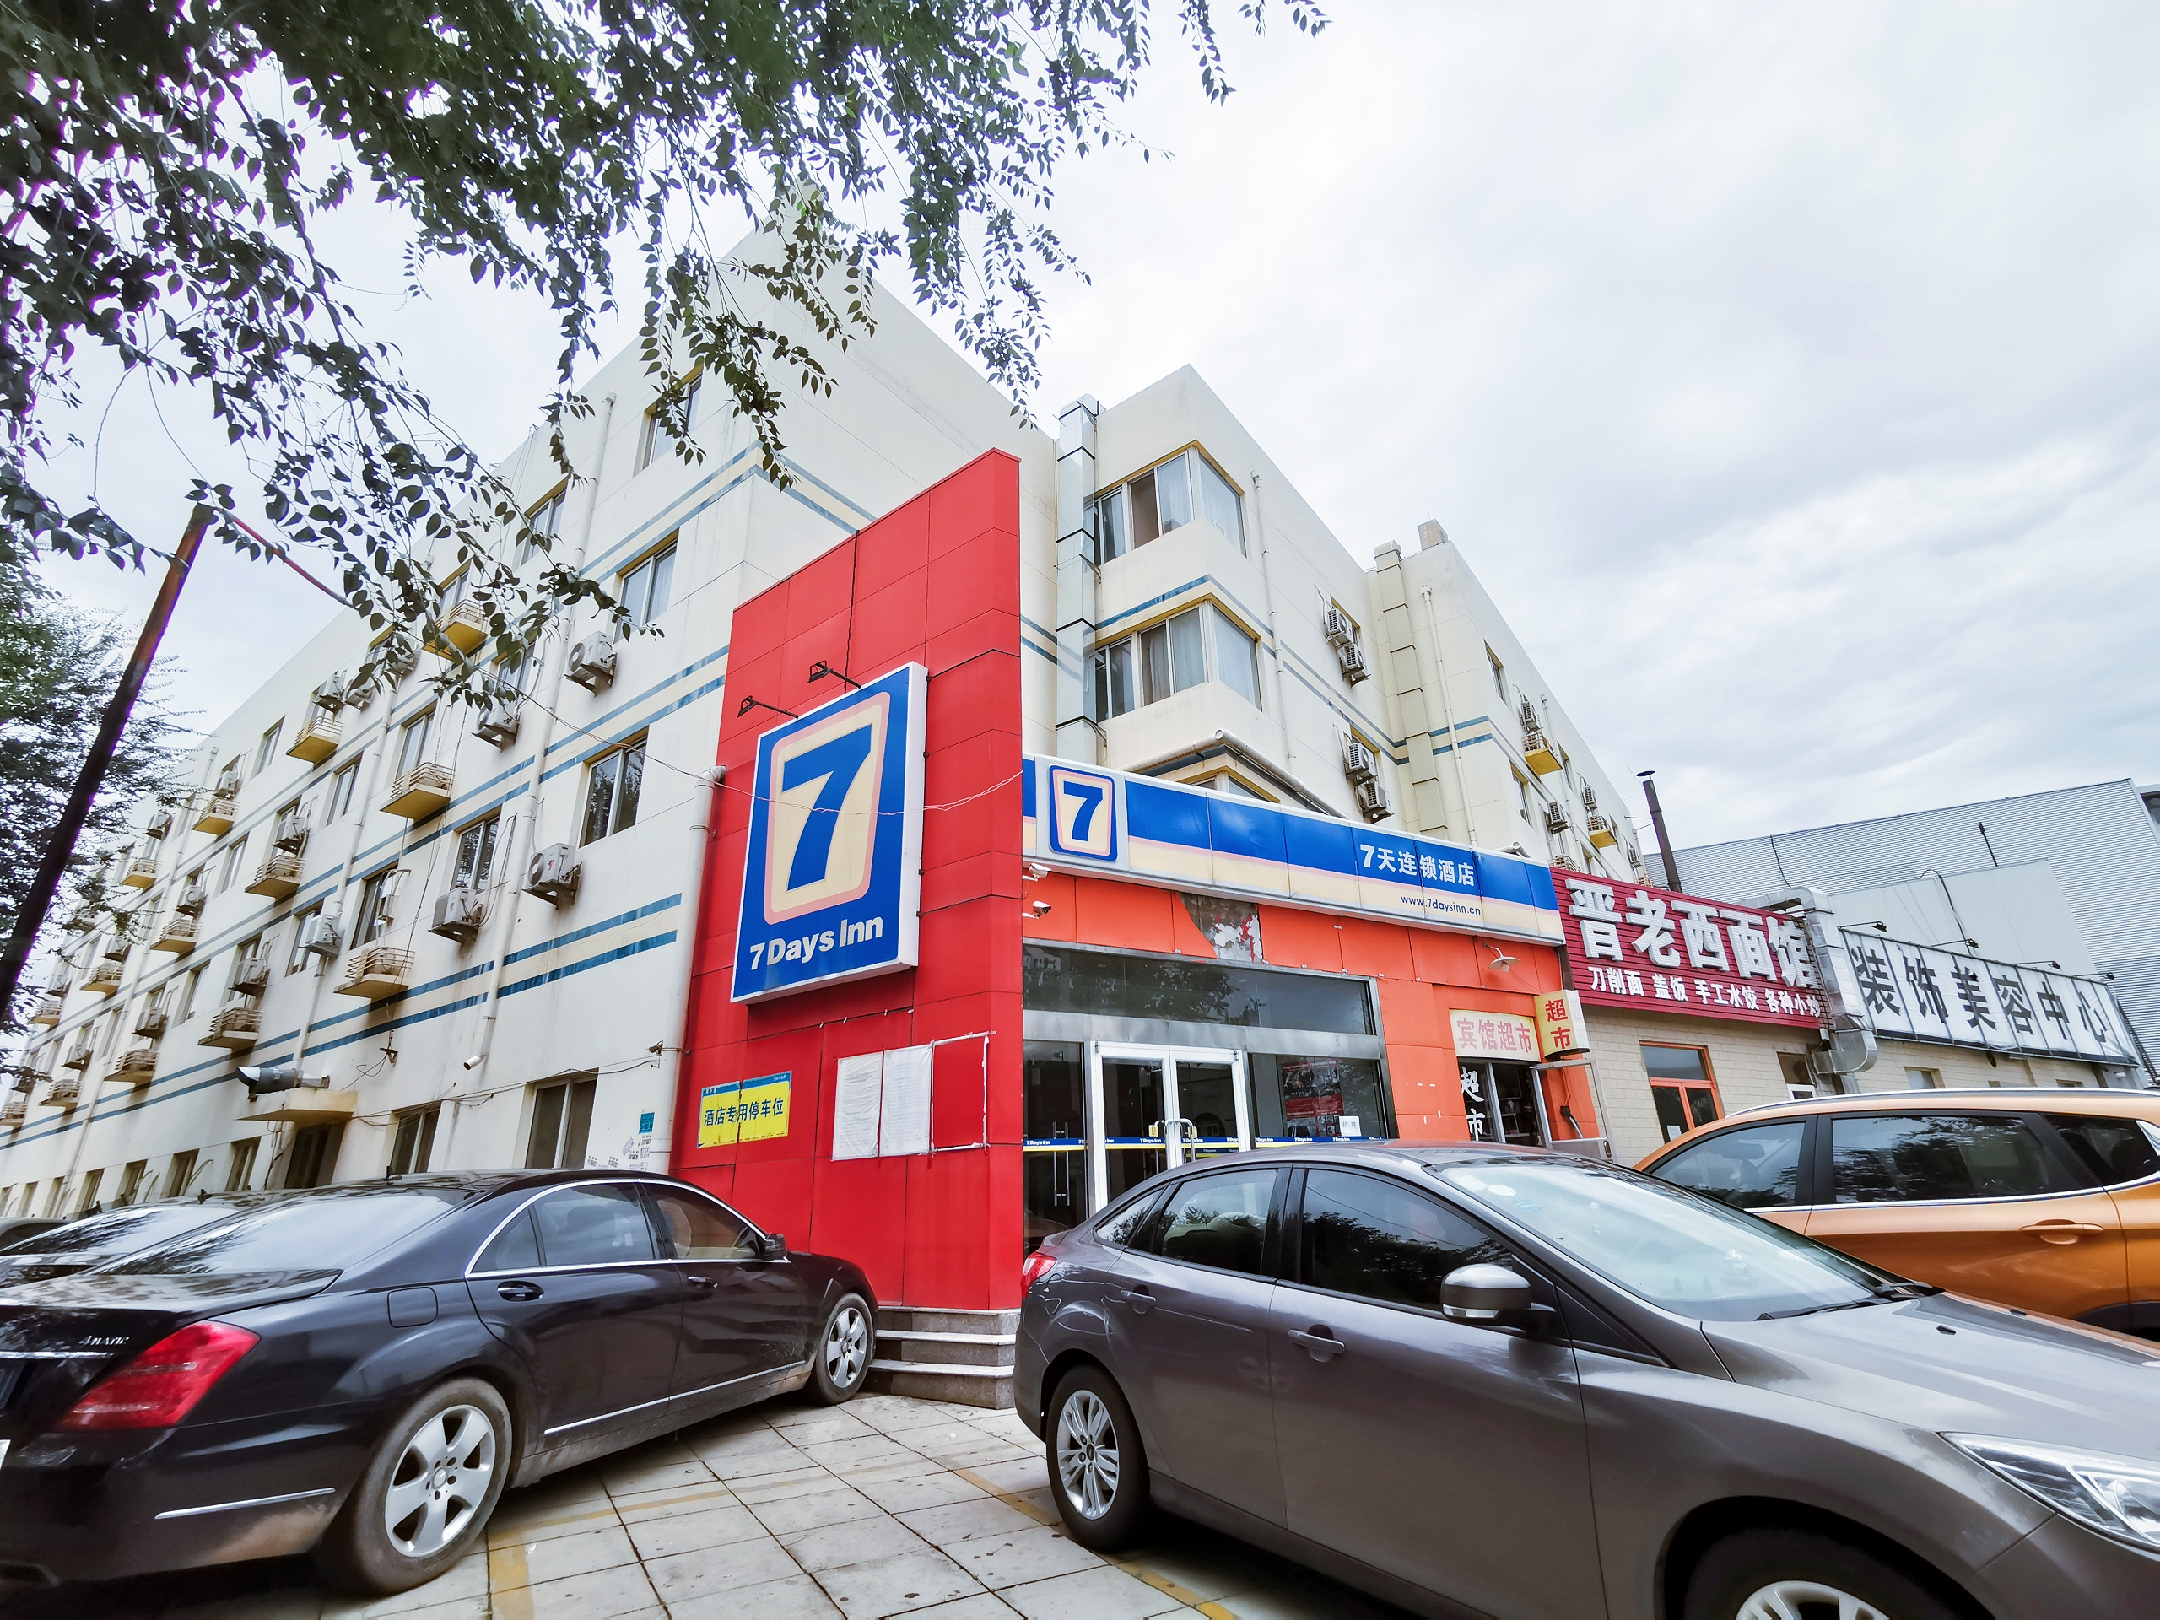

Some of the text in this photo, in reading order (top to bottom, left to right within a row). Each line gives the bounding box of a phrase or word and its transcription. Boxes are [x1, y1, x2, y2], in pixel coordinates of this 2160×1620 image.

[781, 722, 872, 892] 7
[1062, 780, 1103, 842] 7
[1360, 844, 1475, 887] 7天连锁酒店
[1400, 895, 1481, 916] www.7daysinn.cn
[750, 917, 883, 970] 7 Days Inn
[1565, 878, 1820, 989] 晋老西面馆
[1588, 966, 1820, 1018] 刀削面 盖饭 手工水饺 各种小炒
[1851, 946, 2108, 1043] 装饰美容中心
[1456, 1018, 1533, 1053] 宾馆超市
[1546, 999, 1571, 1049] 超市
[704, 1097, 784, 1127] 酒店专用停车位
[1461, 1066, 1485, 1141] 超市
